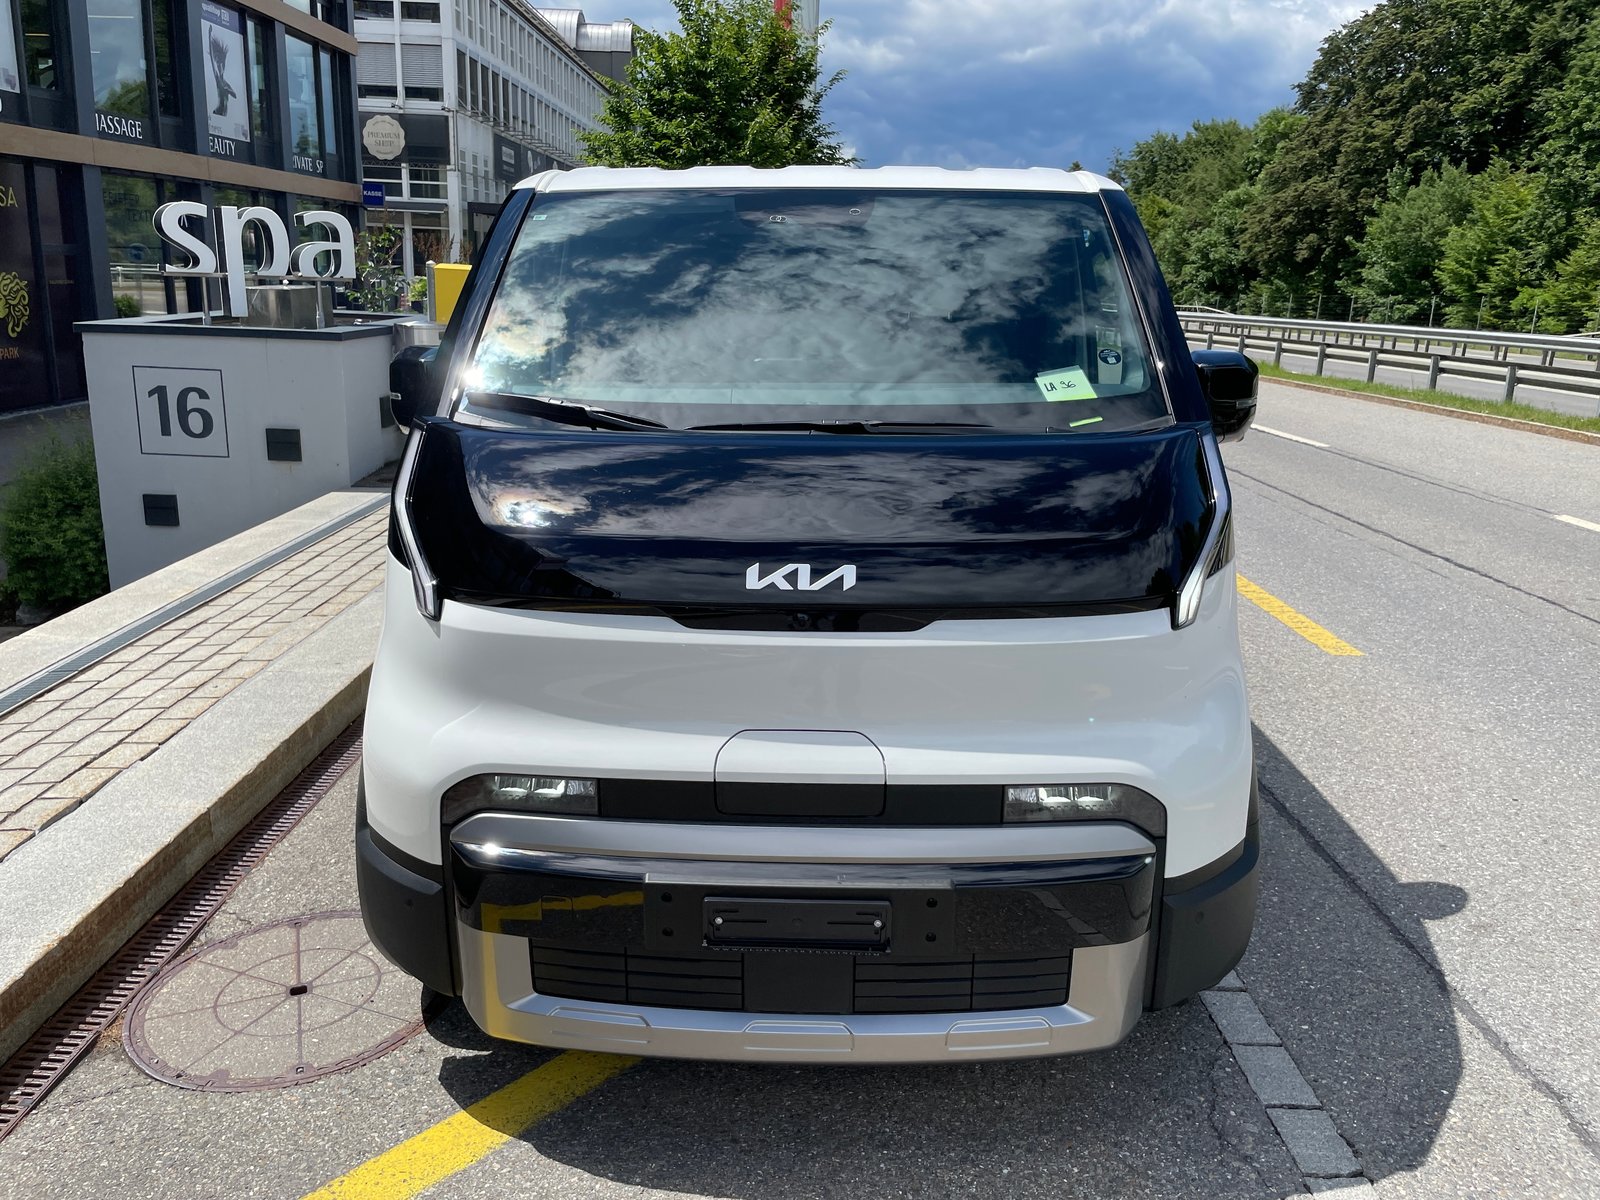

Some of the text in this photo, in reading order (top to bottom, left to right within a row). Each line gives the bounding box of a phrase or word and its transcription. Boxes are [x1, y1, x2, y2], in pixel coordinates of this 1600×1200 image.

[153, 201, 356, 317] spa
[1044, 382, 1058, 392] LA
[147, 385, 215, 439] 16
[745, 562, 857, 592] KIA
